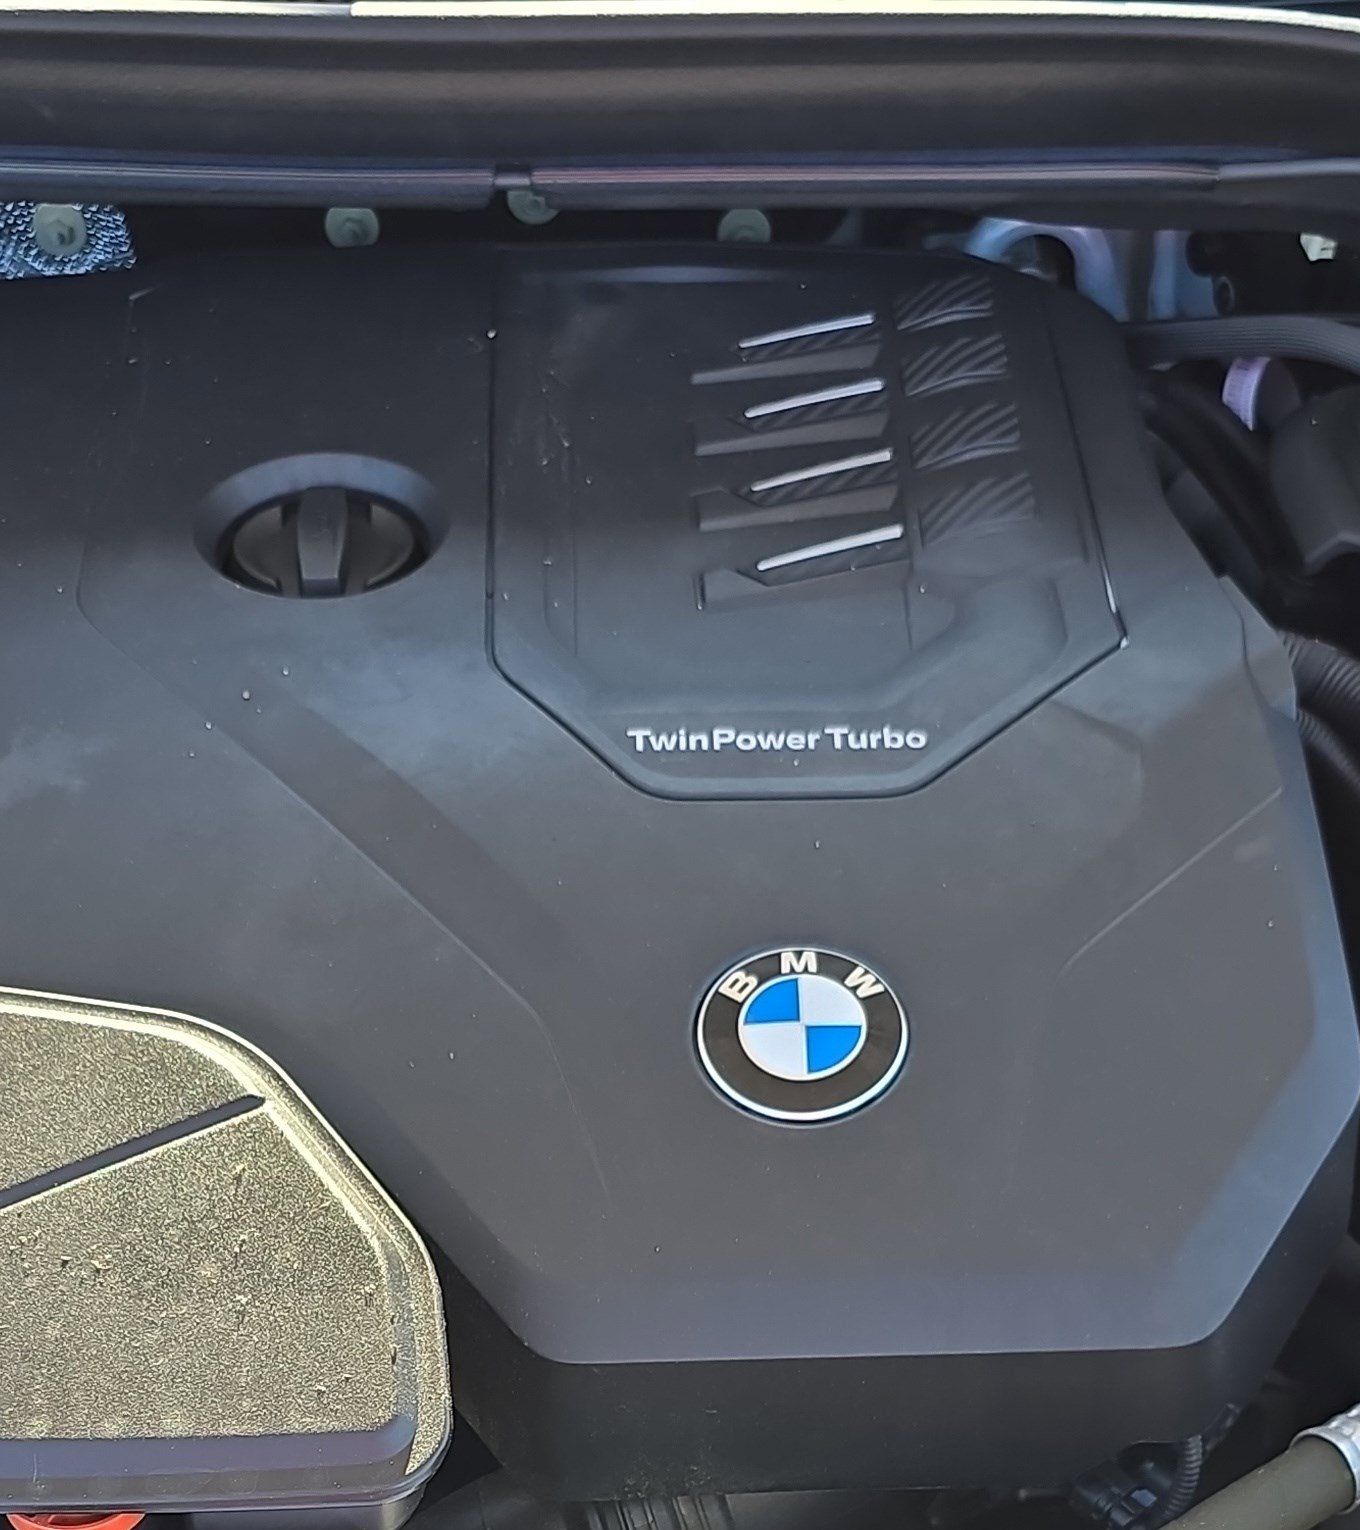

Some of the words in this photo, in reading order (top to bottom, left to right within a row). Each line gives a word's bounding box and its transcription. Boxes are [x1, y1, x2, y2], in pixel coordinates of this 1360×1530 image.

[626, 724, 821, 752] TwinPower
[824, 723, 928, 750] Turbo
[717, 950, 886, 1003] BMW
